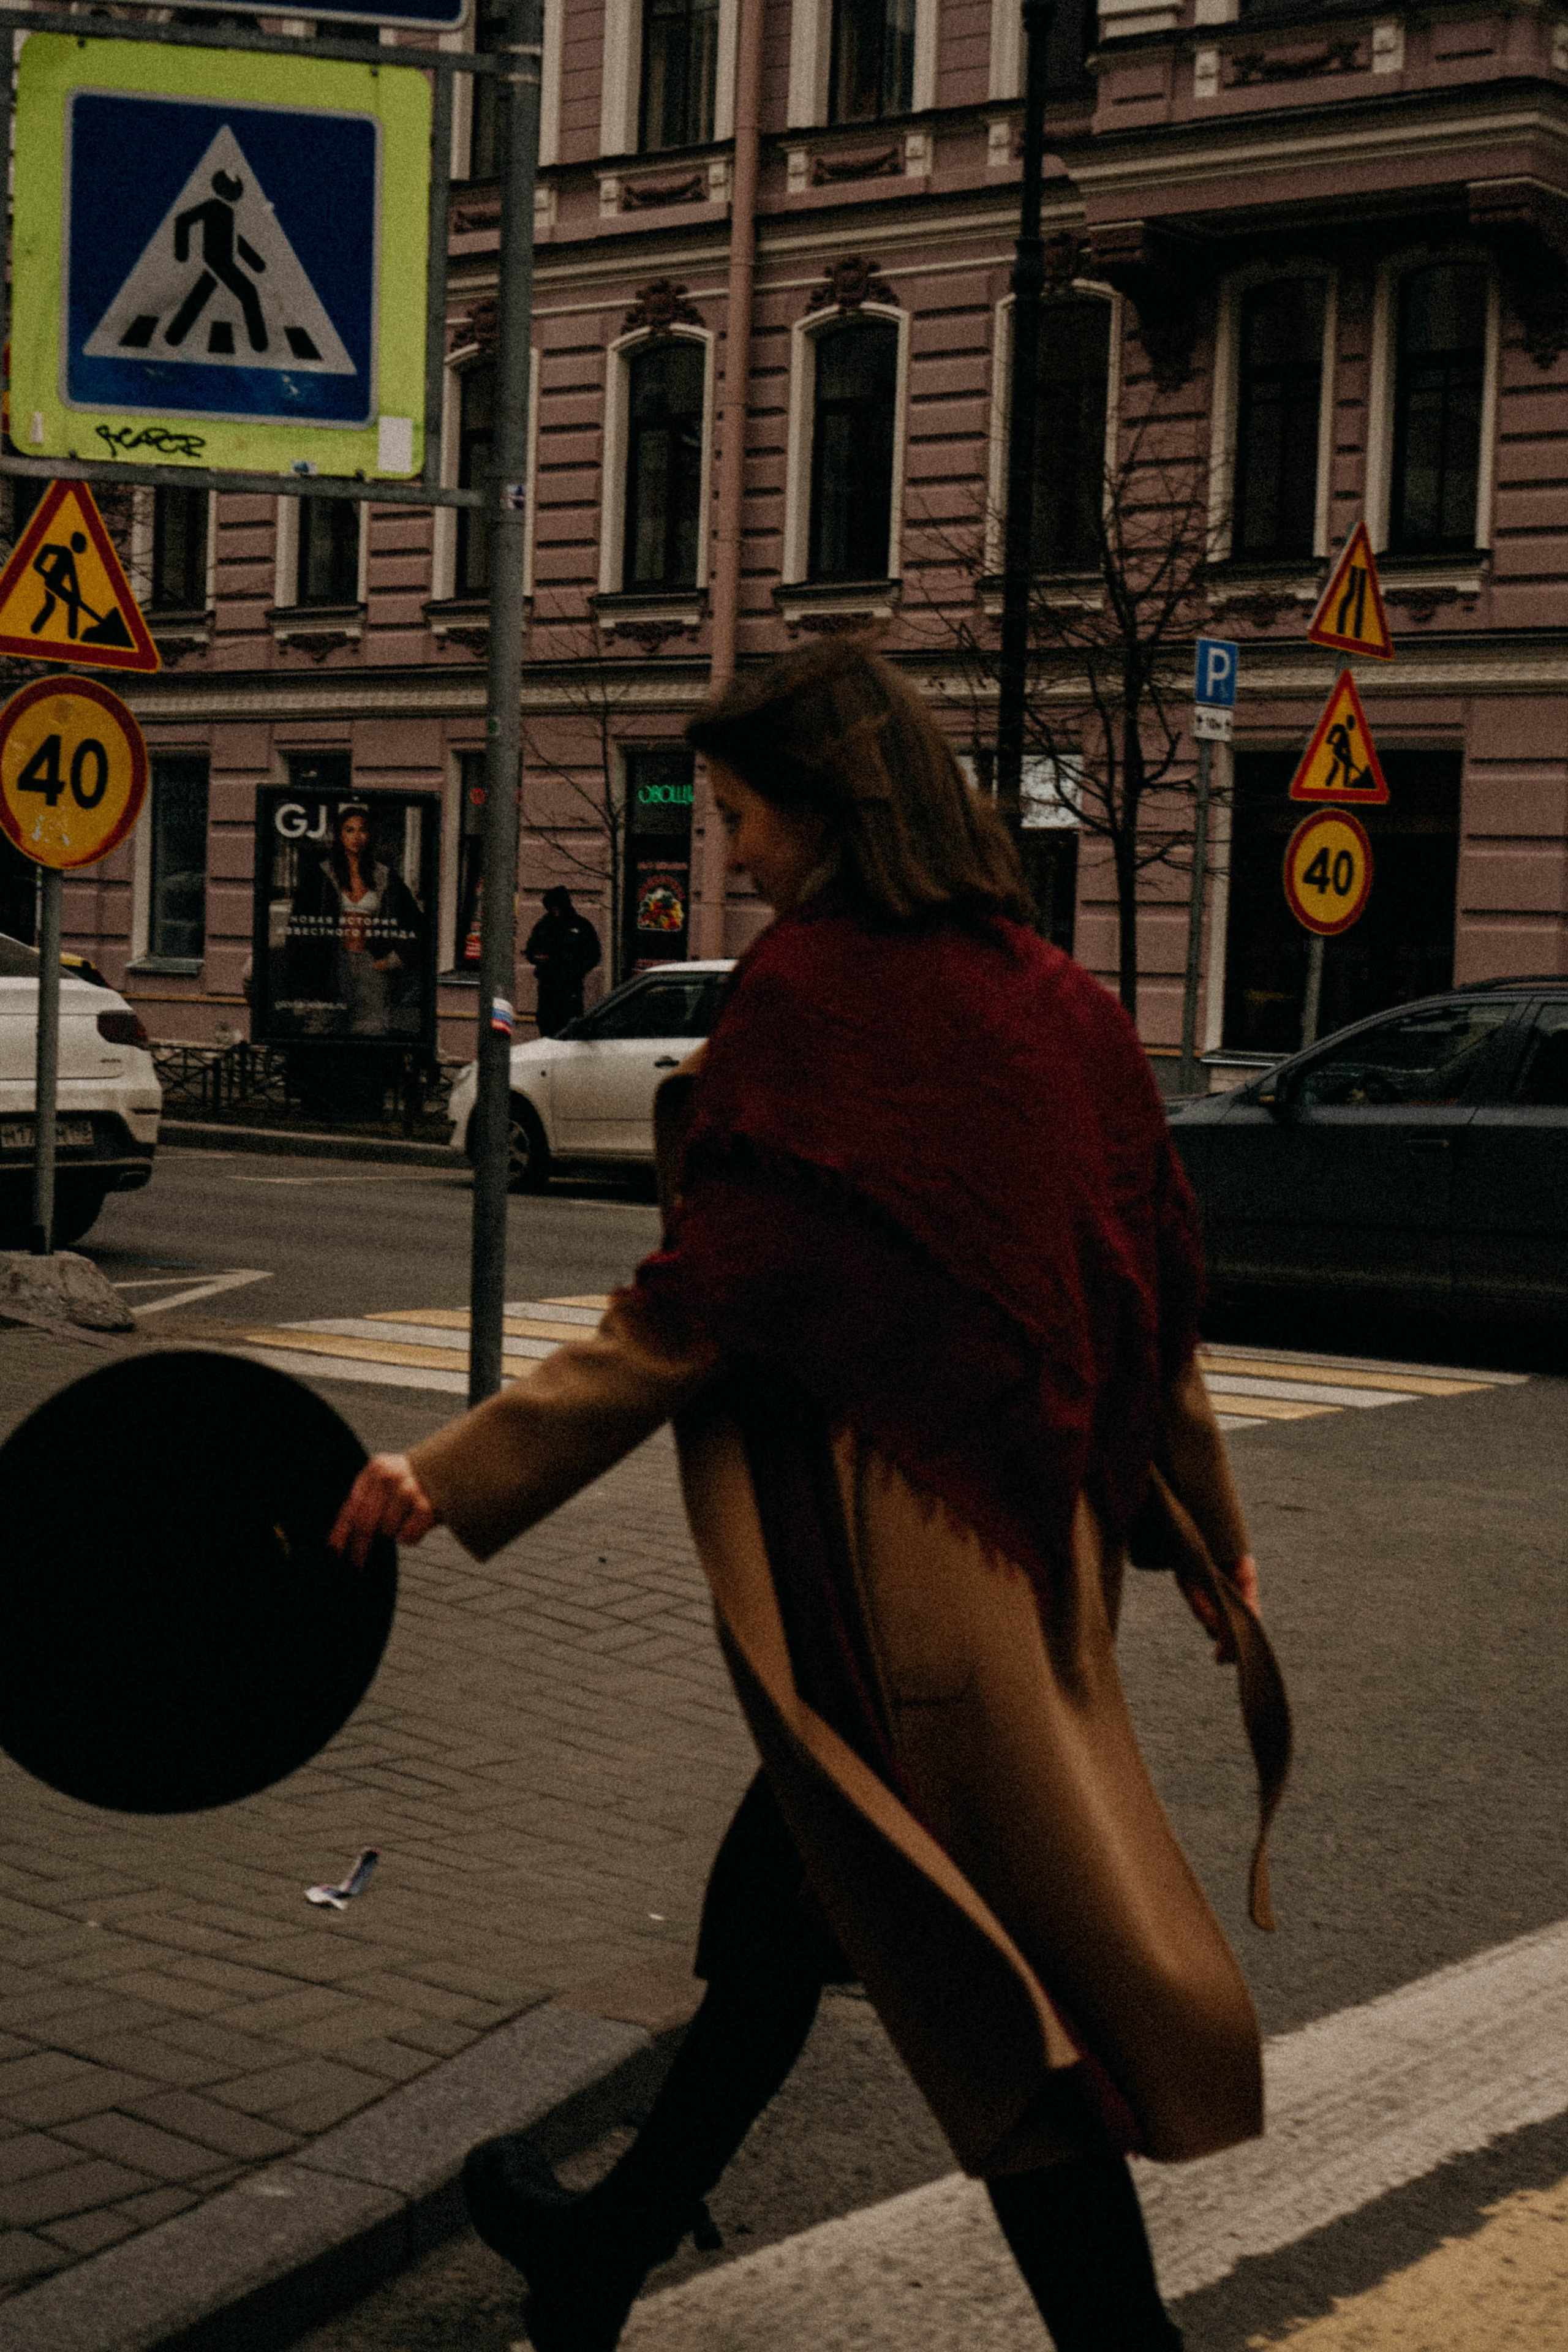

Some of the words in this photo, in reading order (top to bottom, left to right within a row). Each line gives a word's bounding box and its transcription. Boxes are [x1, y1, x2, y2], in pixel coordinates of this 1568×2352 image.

[1206, 646, 1231, 698] P
[17, 734, 108, 810] 40
[275, 802, 328, 840] GJ
[1303, 847, 1354, 896] 40
